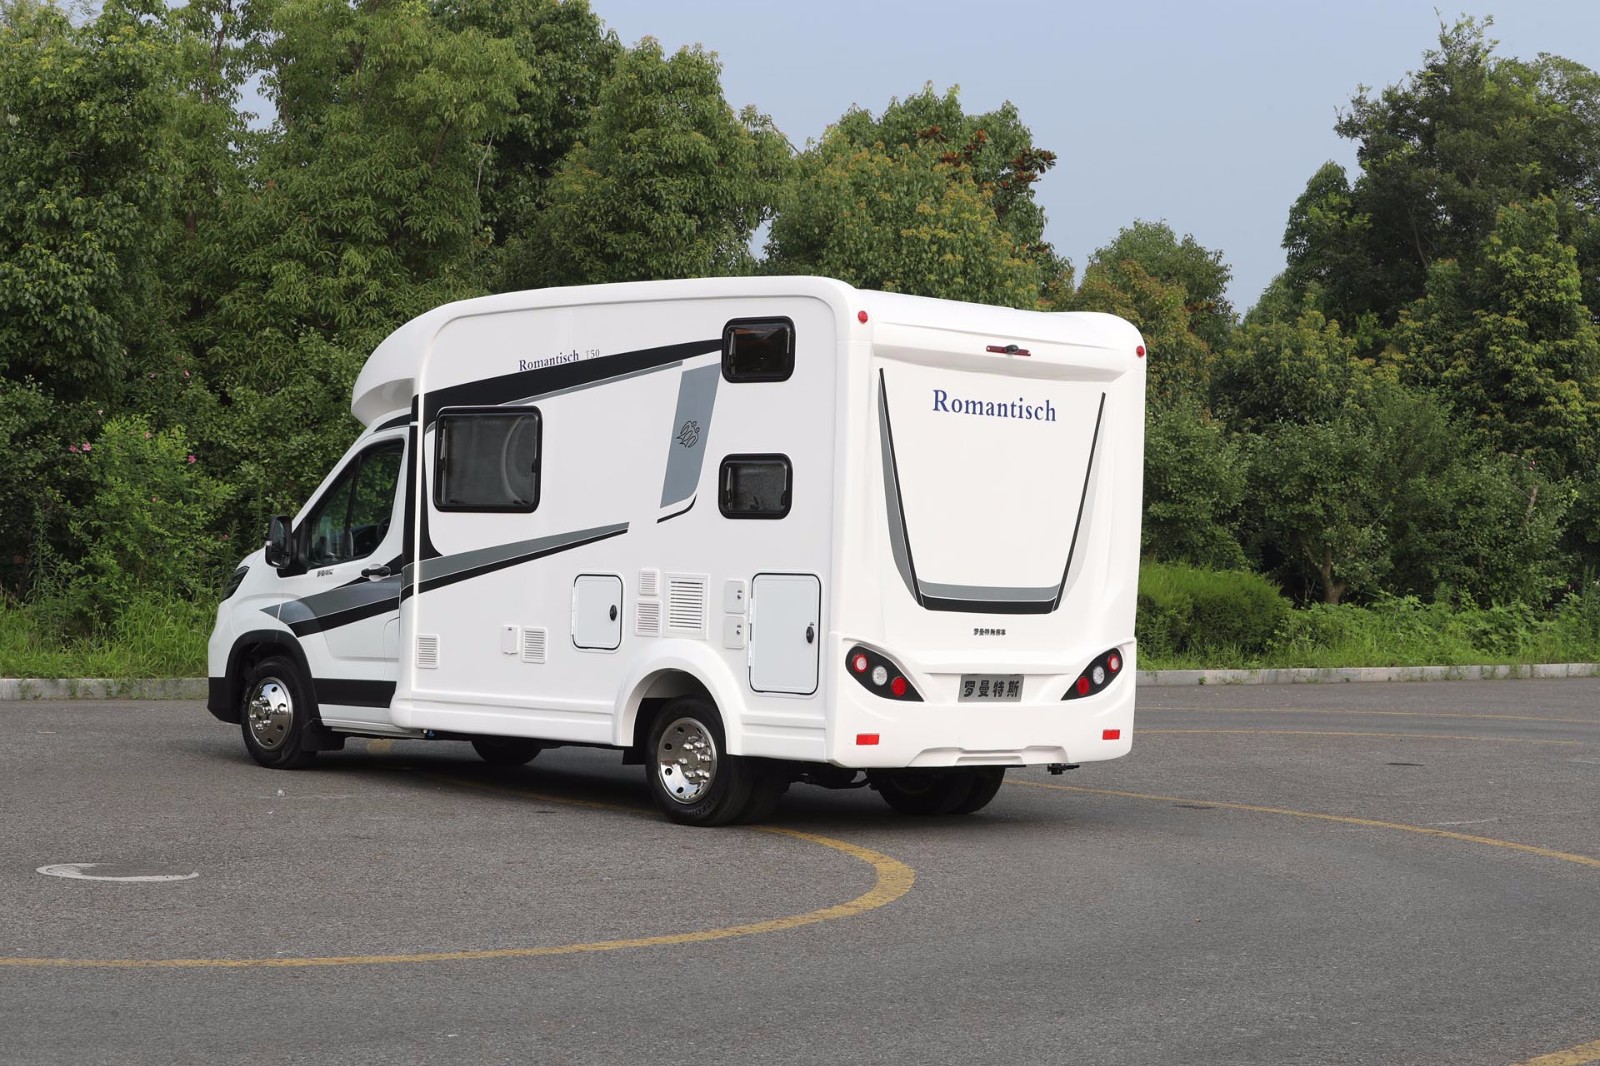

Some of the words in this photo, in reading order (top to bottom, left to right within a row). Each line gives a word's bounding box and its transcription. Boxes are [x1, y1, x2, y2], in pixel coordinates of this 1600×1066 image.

[519, 349, 579, 371] Romantisch
[932, 389, 1056, 422] Romantisch
[963, 680, 1020, 698] 罗曼特斯
